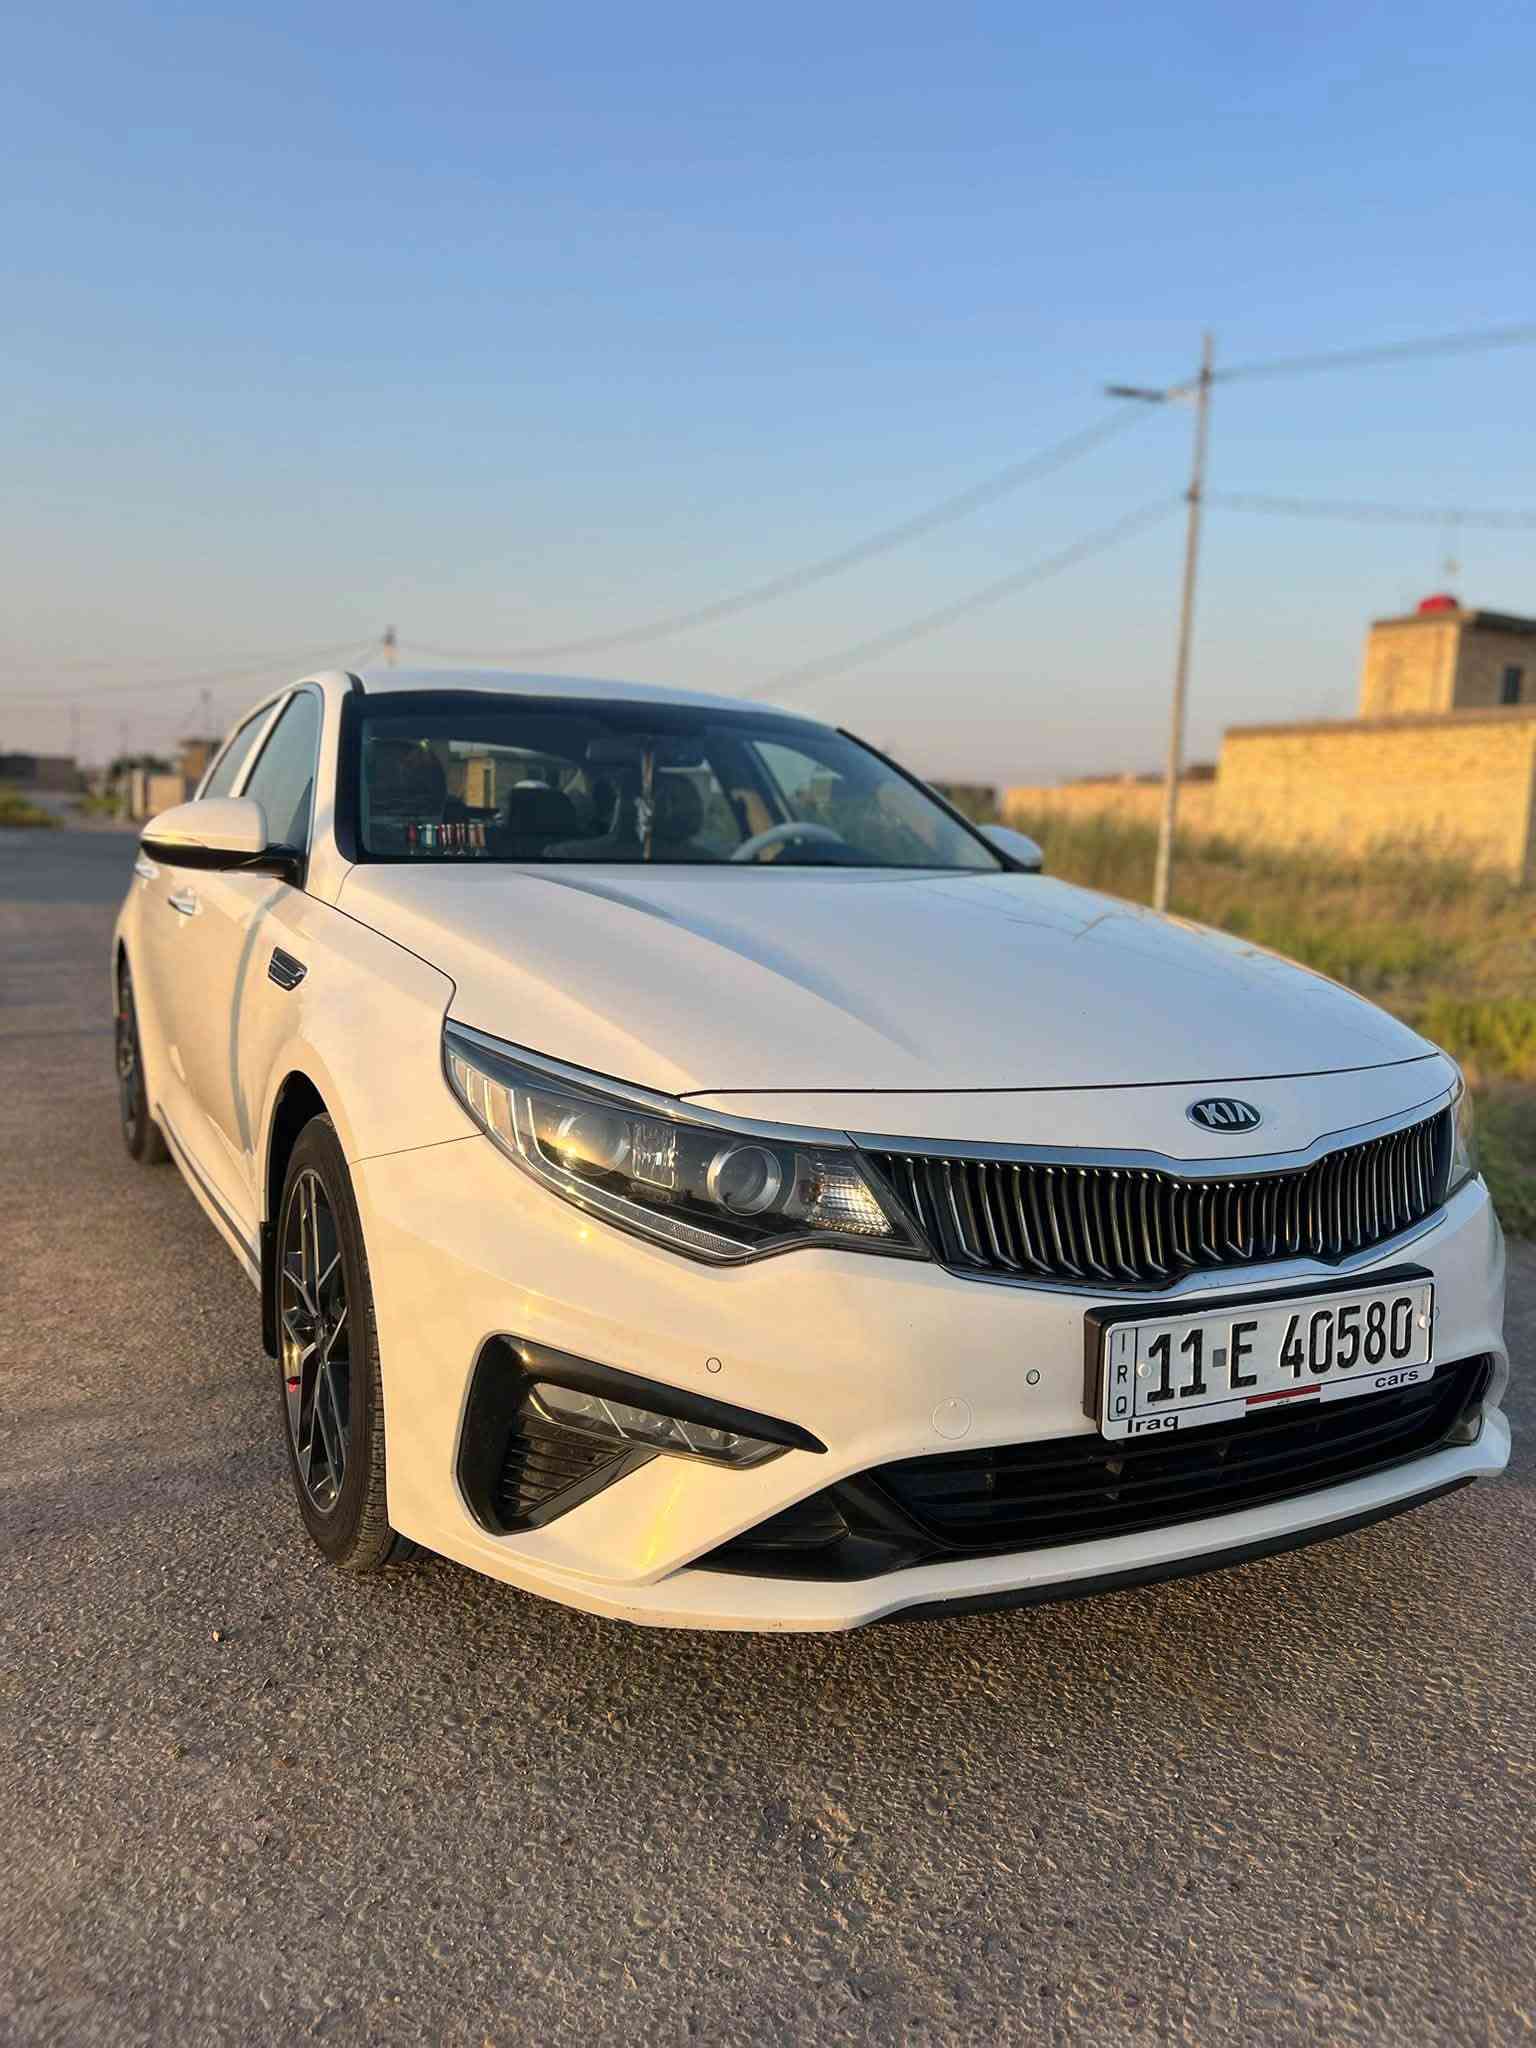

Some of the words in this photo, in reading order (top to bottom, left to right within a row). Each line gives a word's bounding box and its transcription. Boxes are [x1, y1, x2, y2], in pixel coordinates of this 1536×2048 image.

[1279, 1296, 1412, 1379] 40580
[1127, 1415, 1179, 1434] Iraq
[1375, 1368, 1419, 1388] cars
